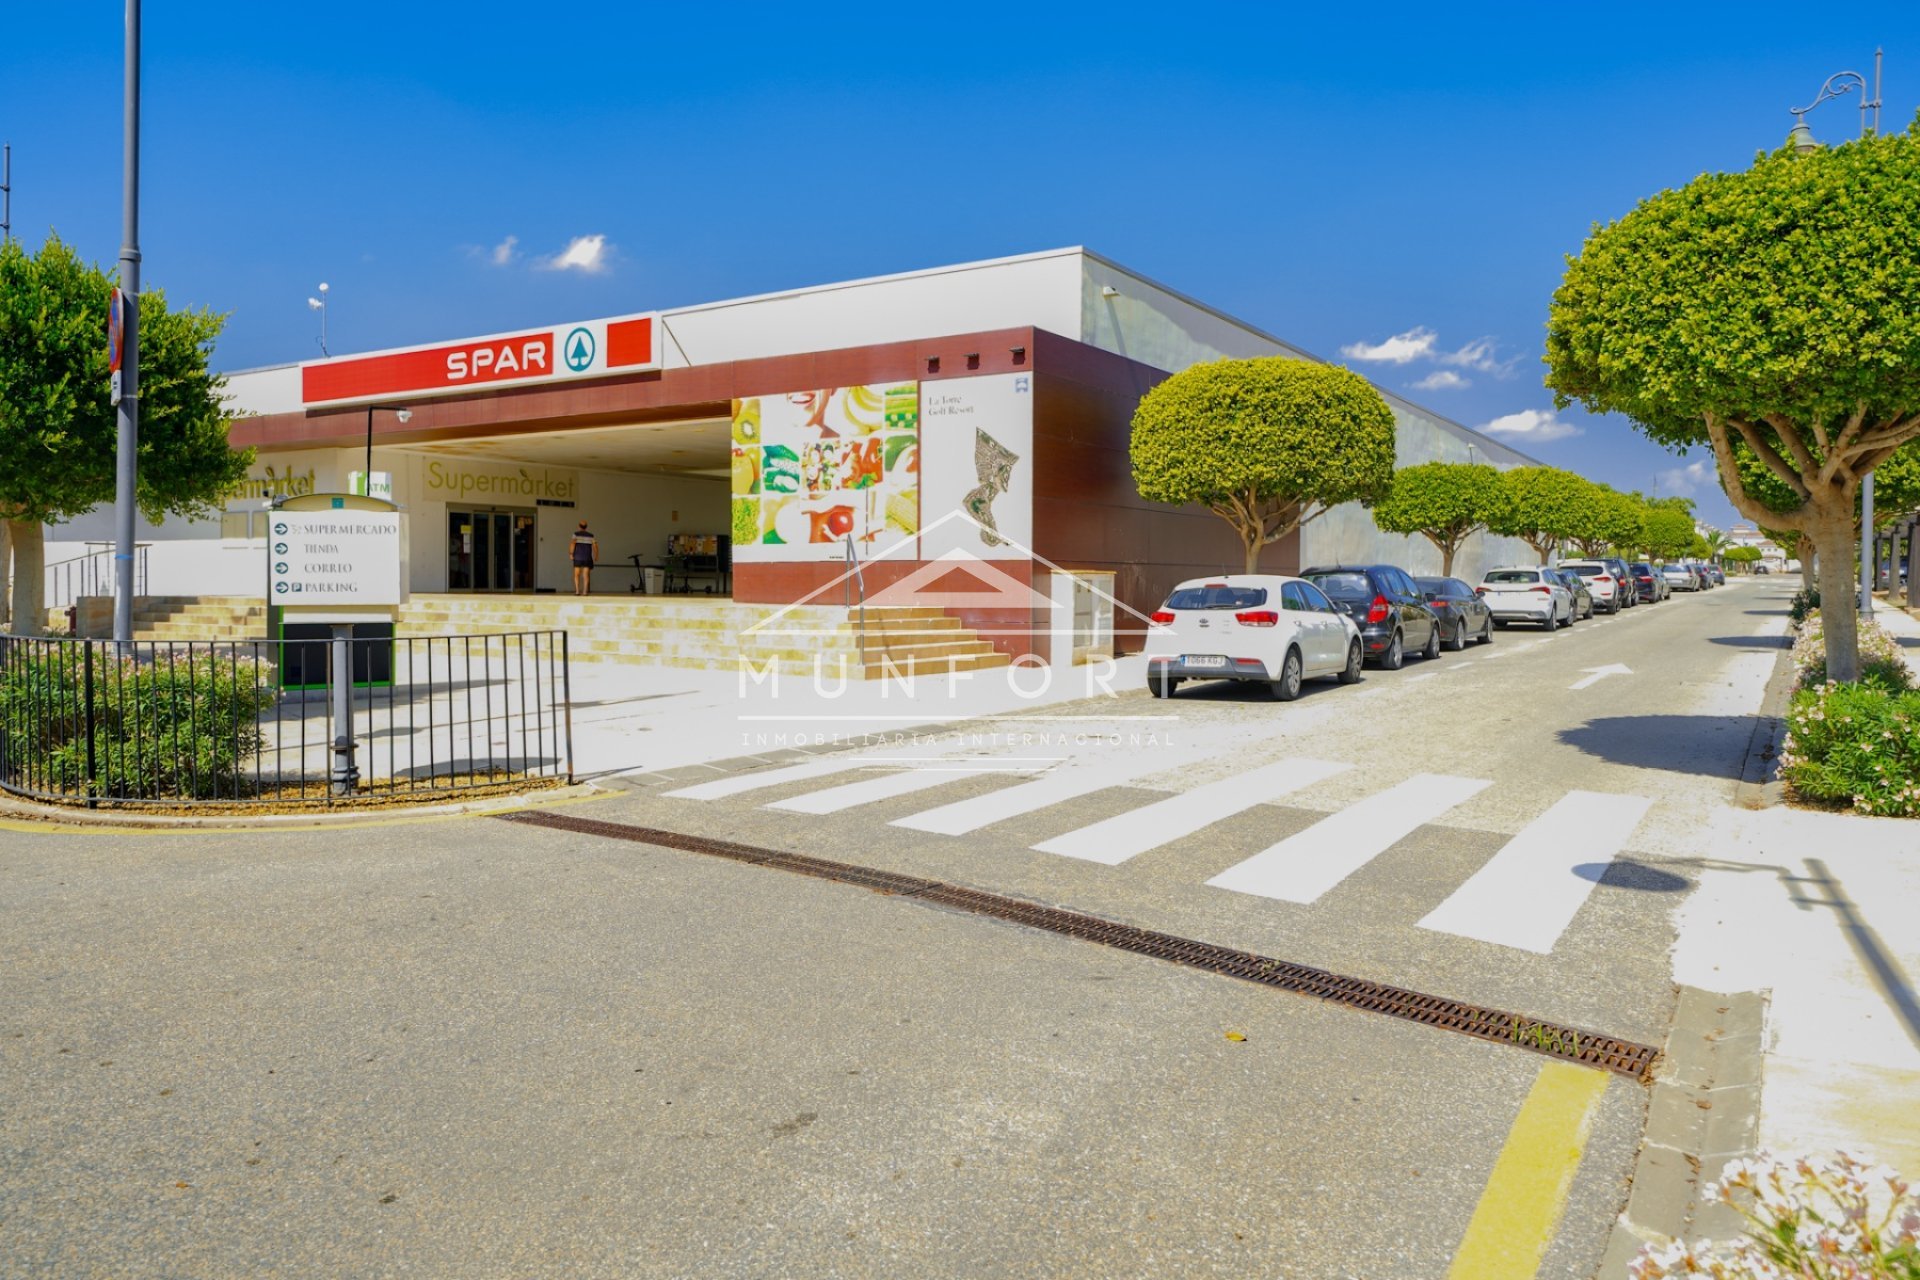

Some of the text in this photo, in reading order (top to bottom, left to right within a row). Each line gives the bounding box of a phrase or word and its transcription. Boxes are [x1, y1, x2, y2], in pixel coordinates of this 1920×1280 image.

[446, 341, 546, 380] SPAR
[304, 544, 339, 554] TIENDA
[304, 563, 353, 574] CORREO
[305, 583, 358, 593] PARKING
